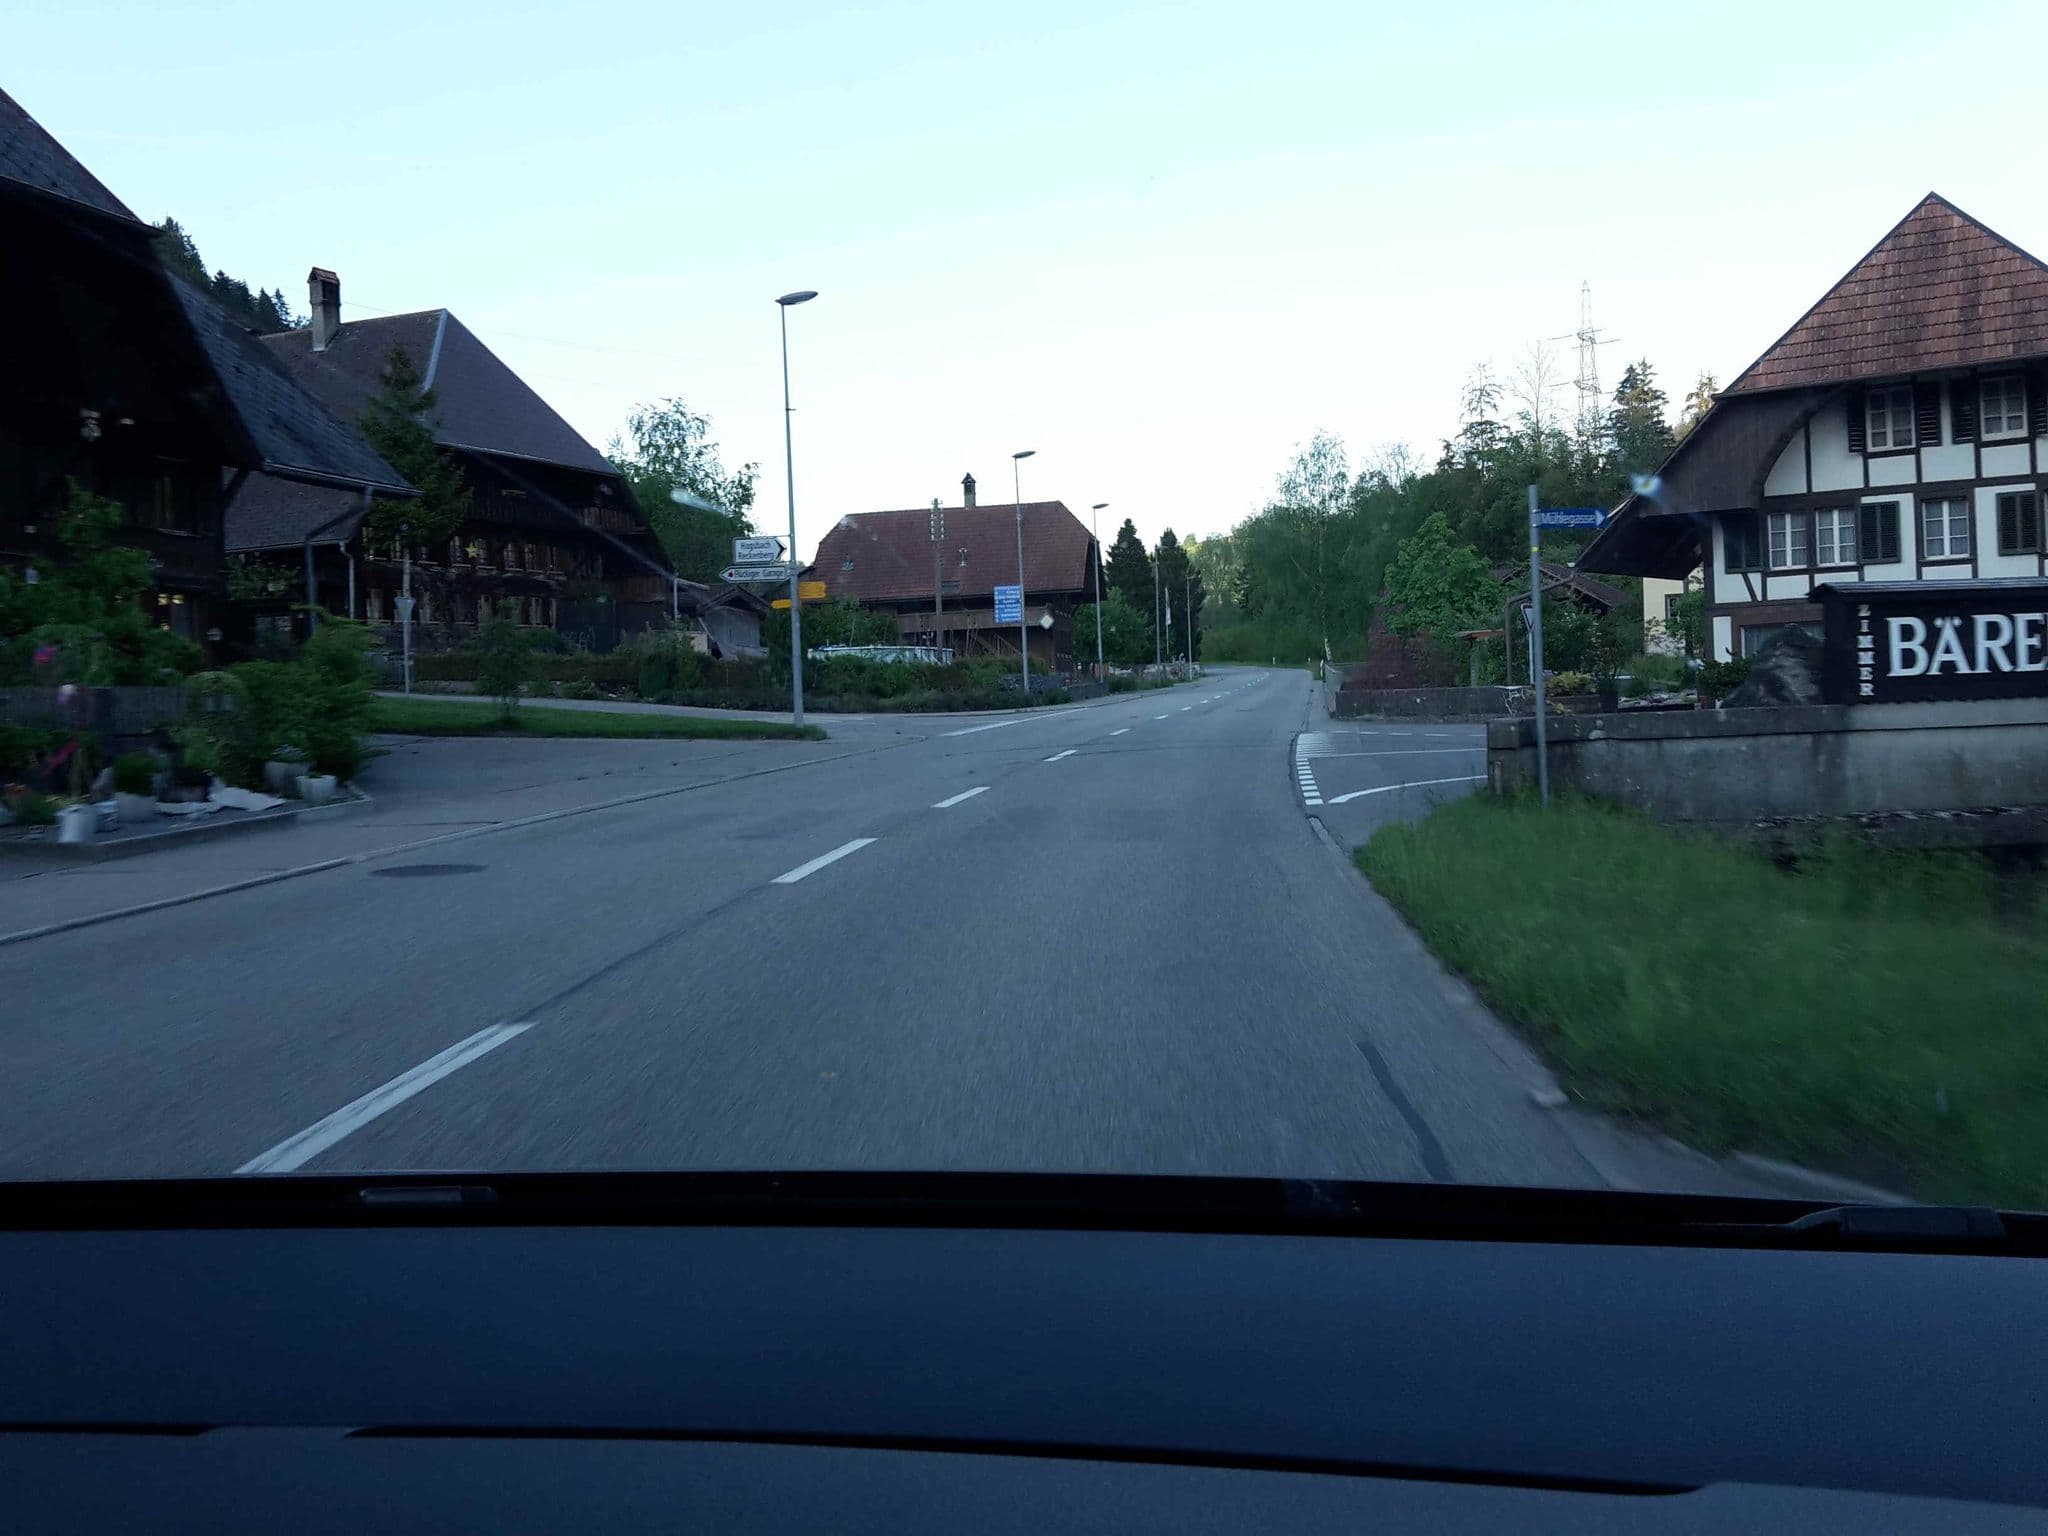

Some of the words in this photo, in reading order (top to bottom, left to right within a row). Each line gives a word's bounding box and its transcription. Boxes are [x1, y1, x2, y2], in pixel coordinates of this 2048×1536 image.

[1541, 512, 1596, 527] Mühlegasse
[1856, 604, 1875, 696] ZIMMER
[1884, 612, 2048, 677] BÄRE
